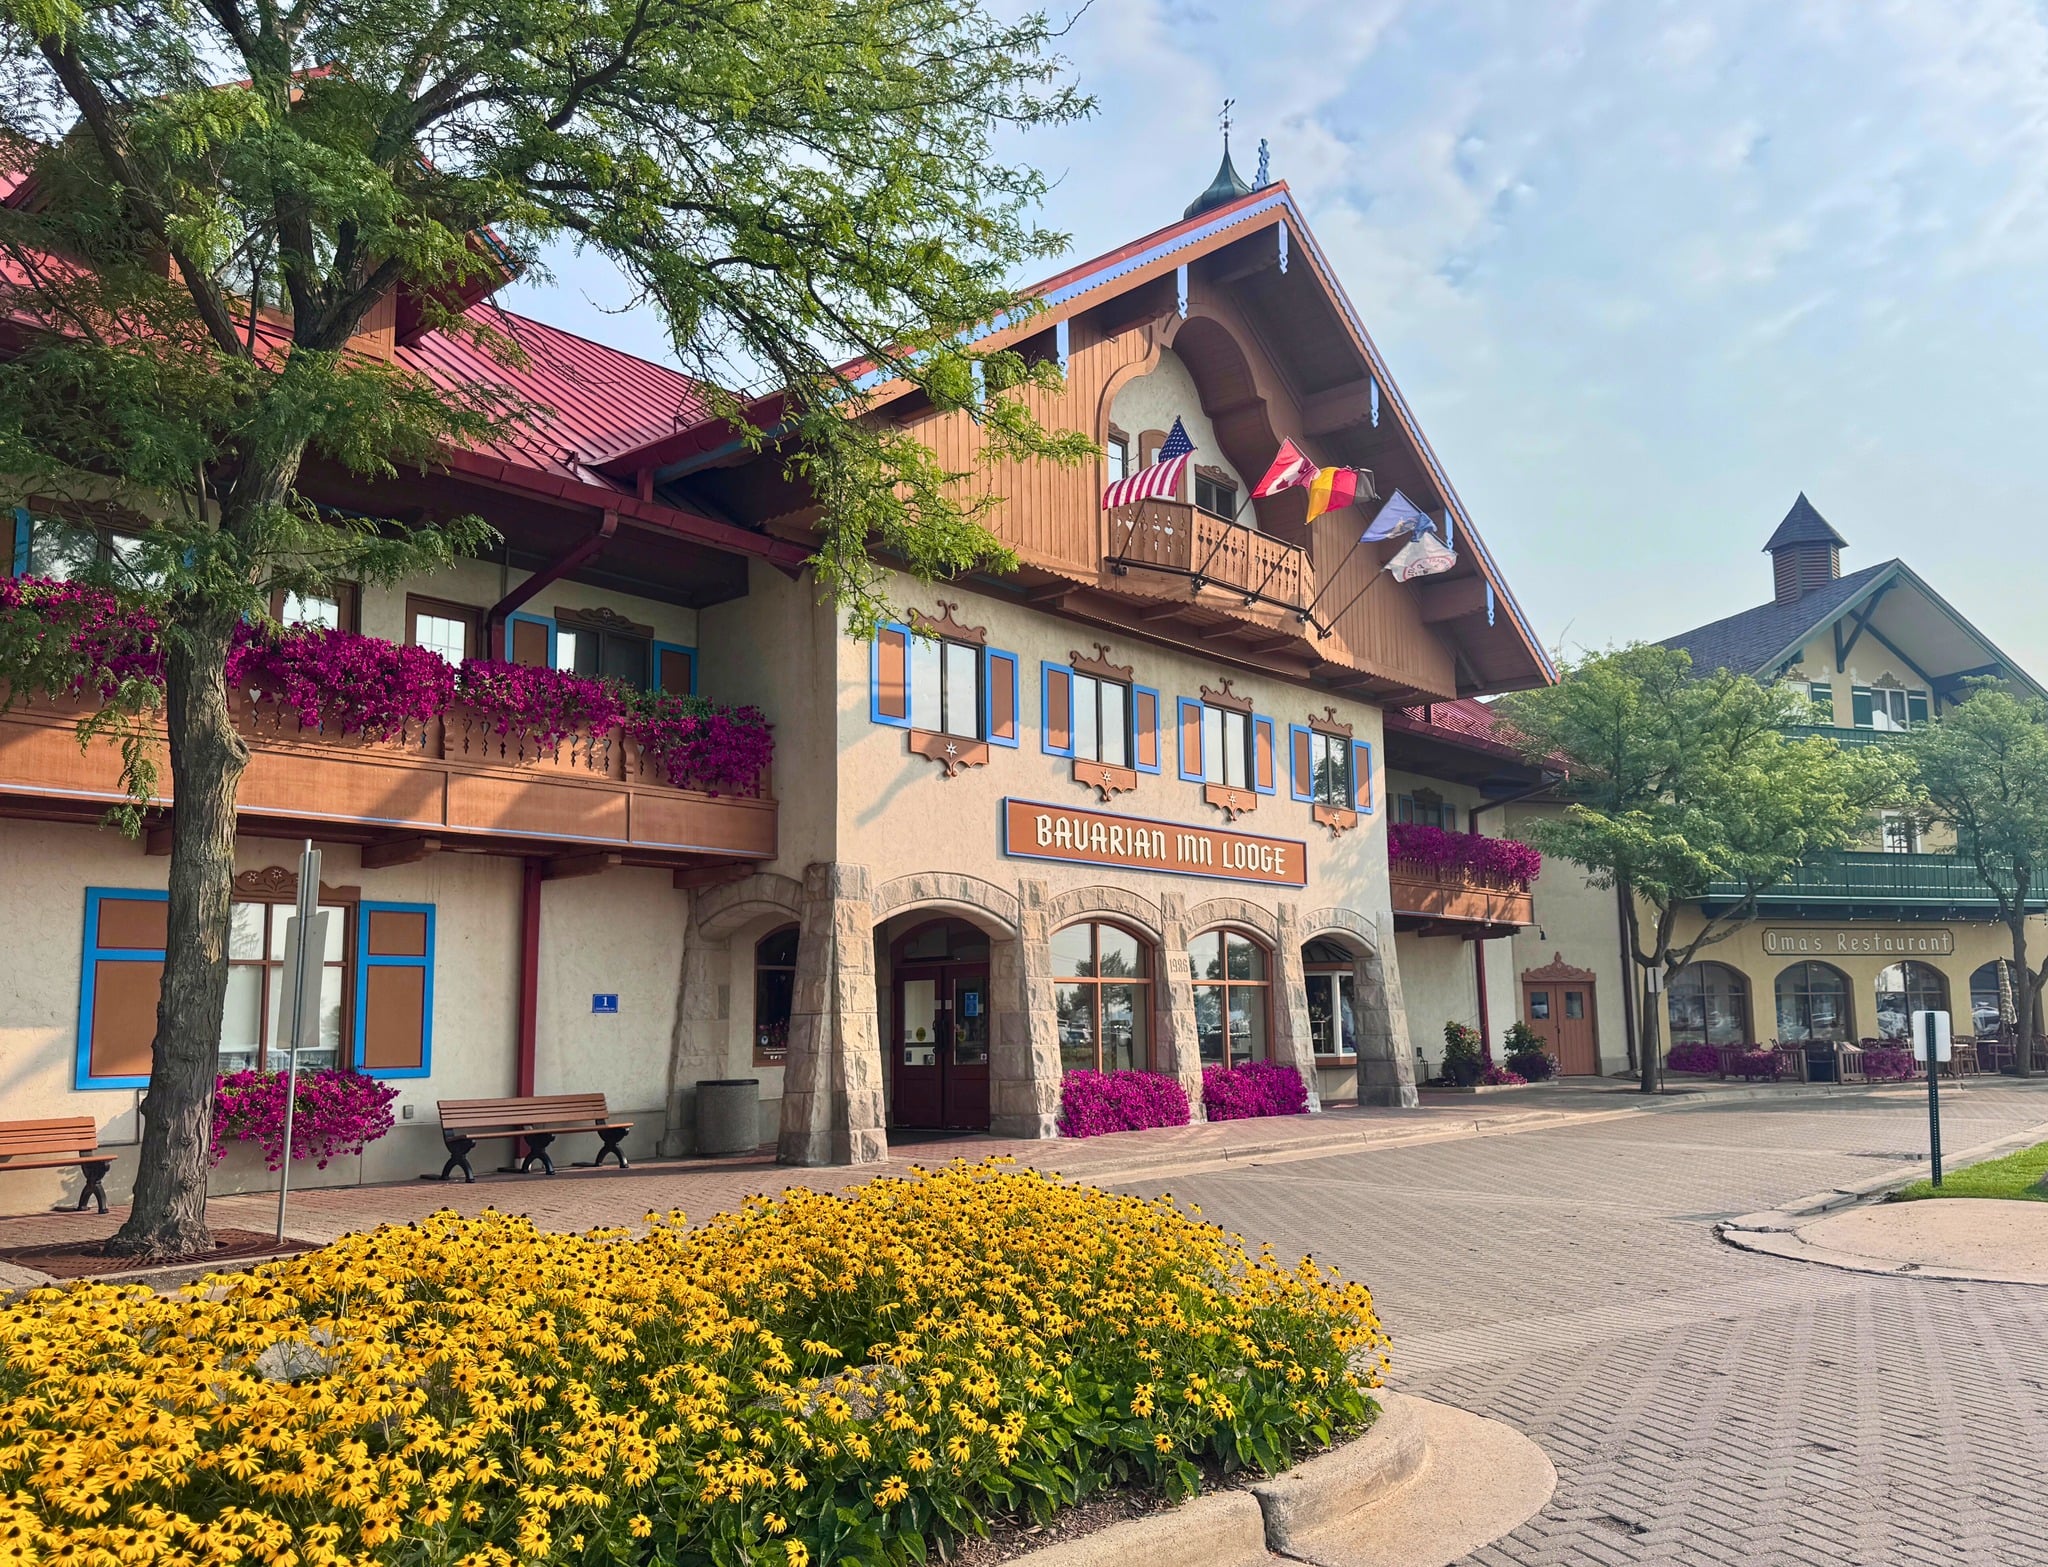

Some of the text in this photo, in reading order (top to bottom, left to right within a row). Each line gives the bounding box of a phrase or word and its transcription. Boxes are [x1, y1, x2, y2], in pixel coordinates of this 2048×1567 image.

[1035, 814, 1166, 861] BAVARIAN
[1222, 840, 1286, 875] LODGE
[1837, 932, 1949, 951] Restaurant
[602, 996, 608, 1006] 1
